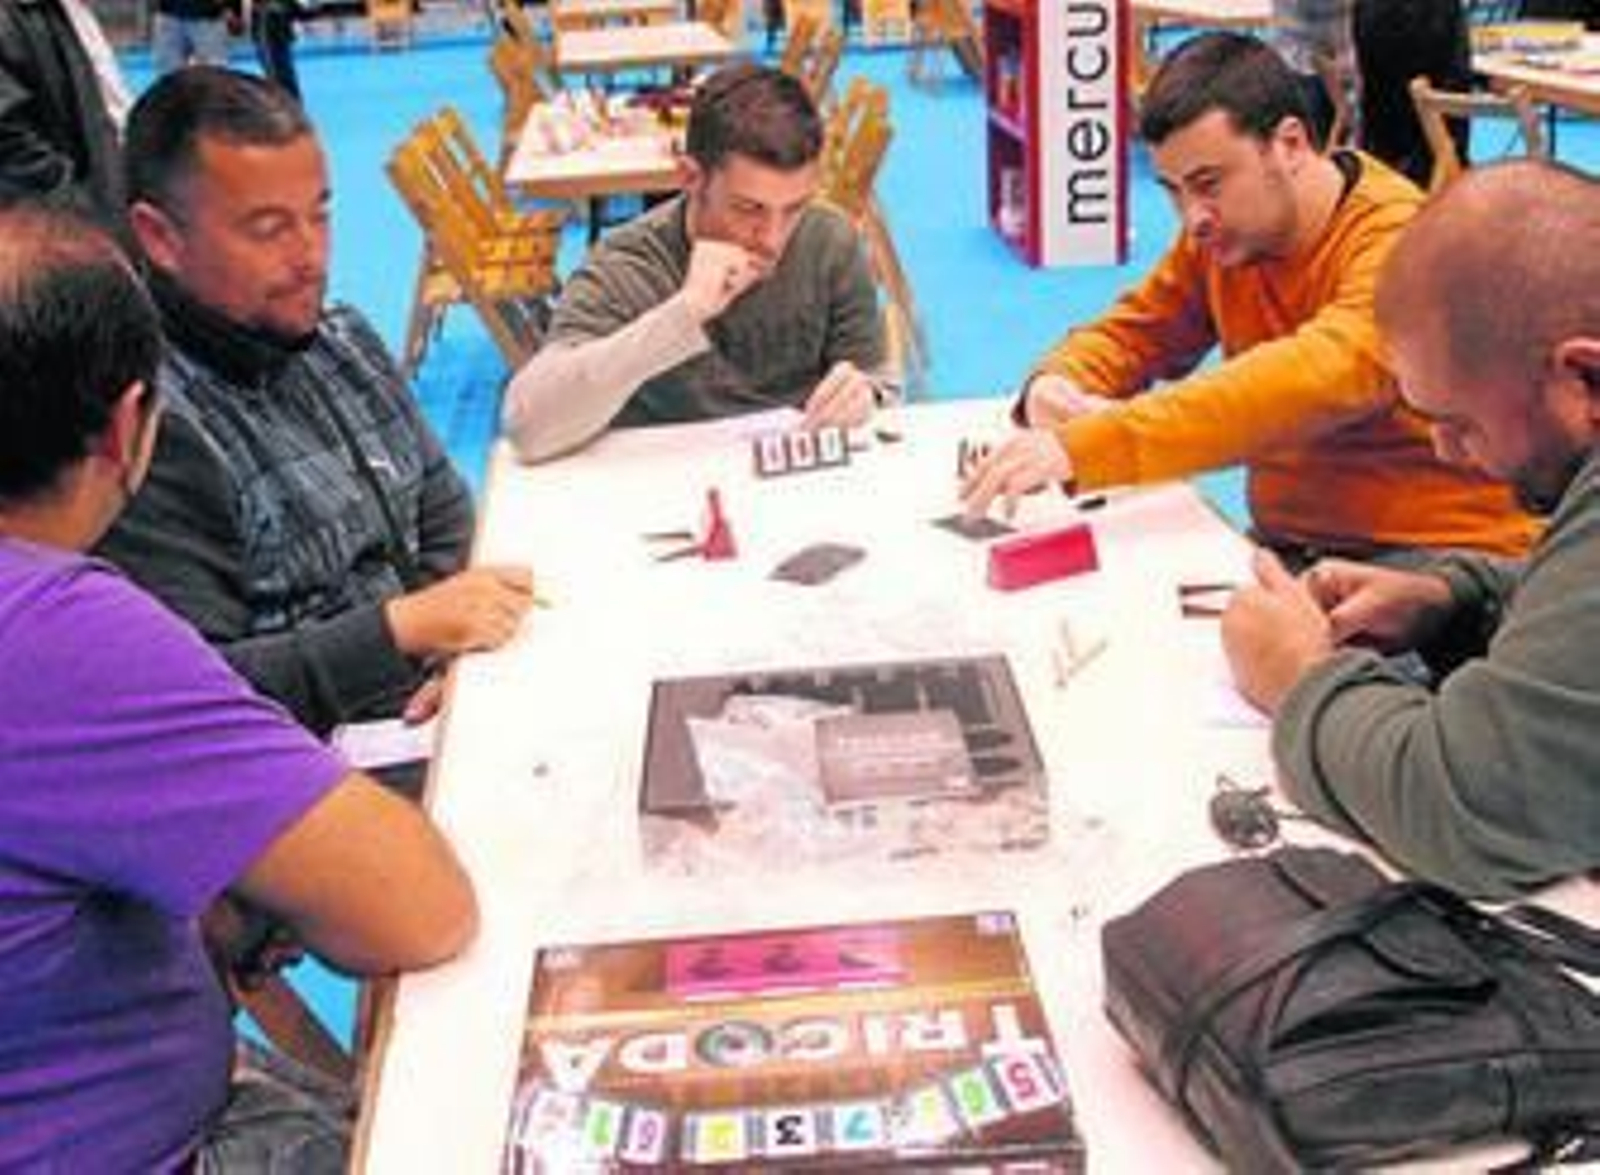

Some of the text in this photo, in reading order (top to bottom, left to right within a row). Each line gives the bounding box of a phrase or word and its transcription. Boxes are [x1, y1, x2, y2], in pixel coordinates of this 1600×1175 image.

[1066, 2, 1109, 225] mercu
[539, 1005, 1051, 1091] TRICODA
[1009, 1061, 1038, 1098] 5
[774, 1115, 804, 1145] 3
[844, 1111, 874, 1140] 7
